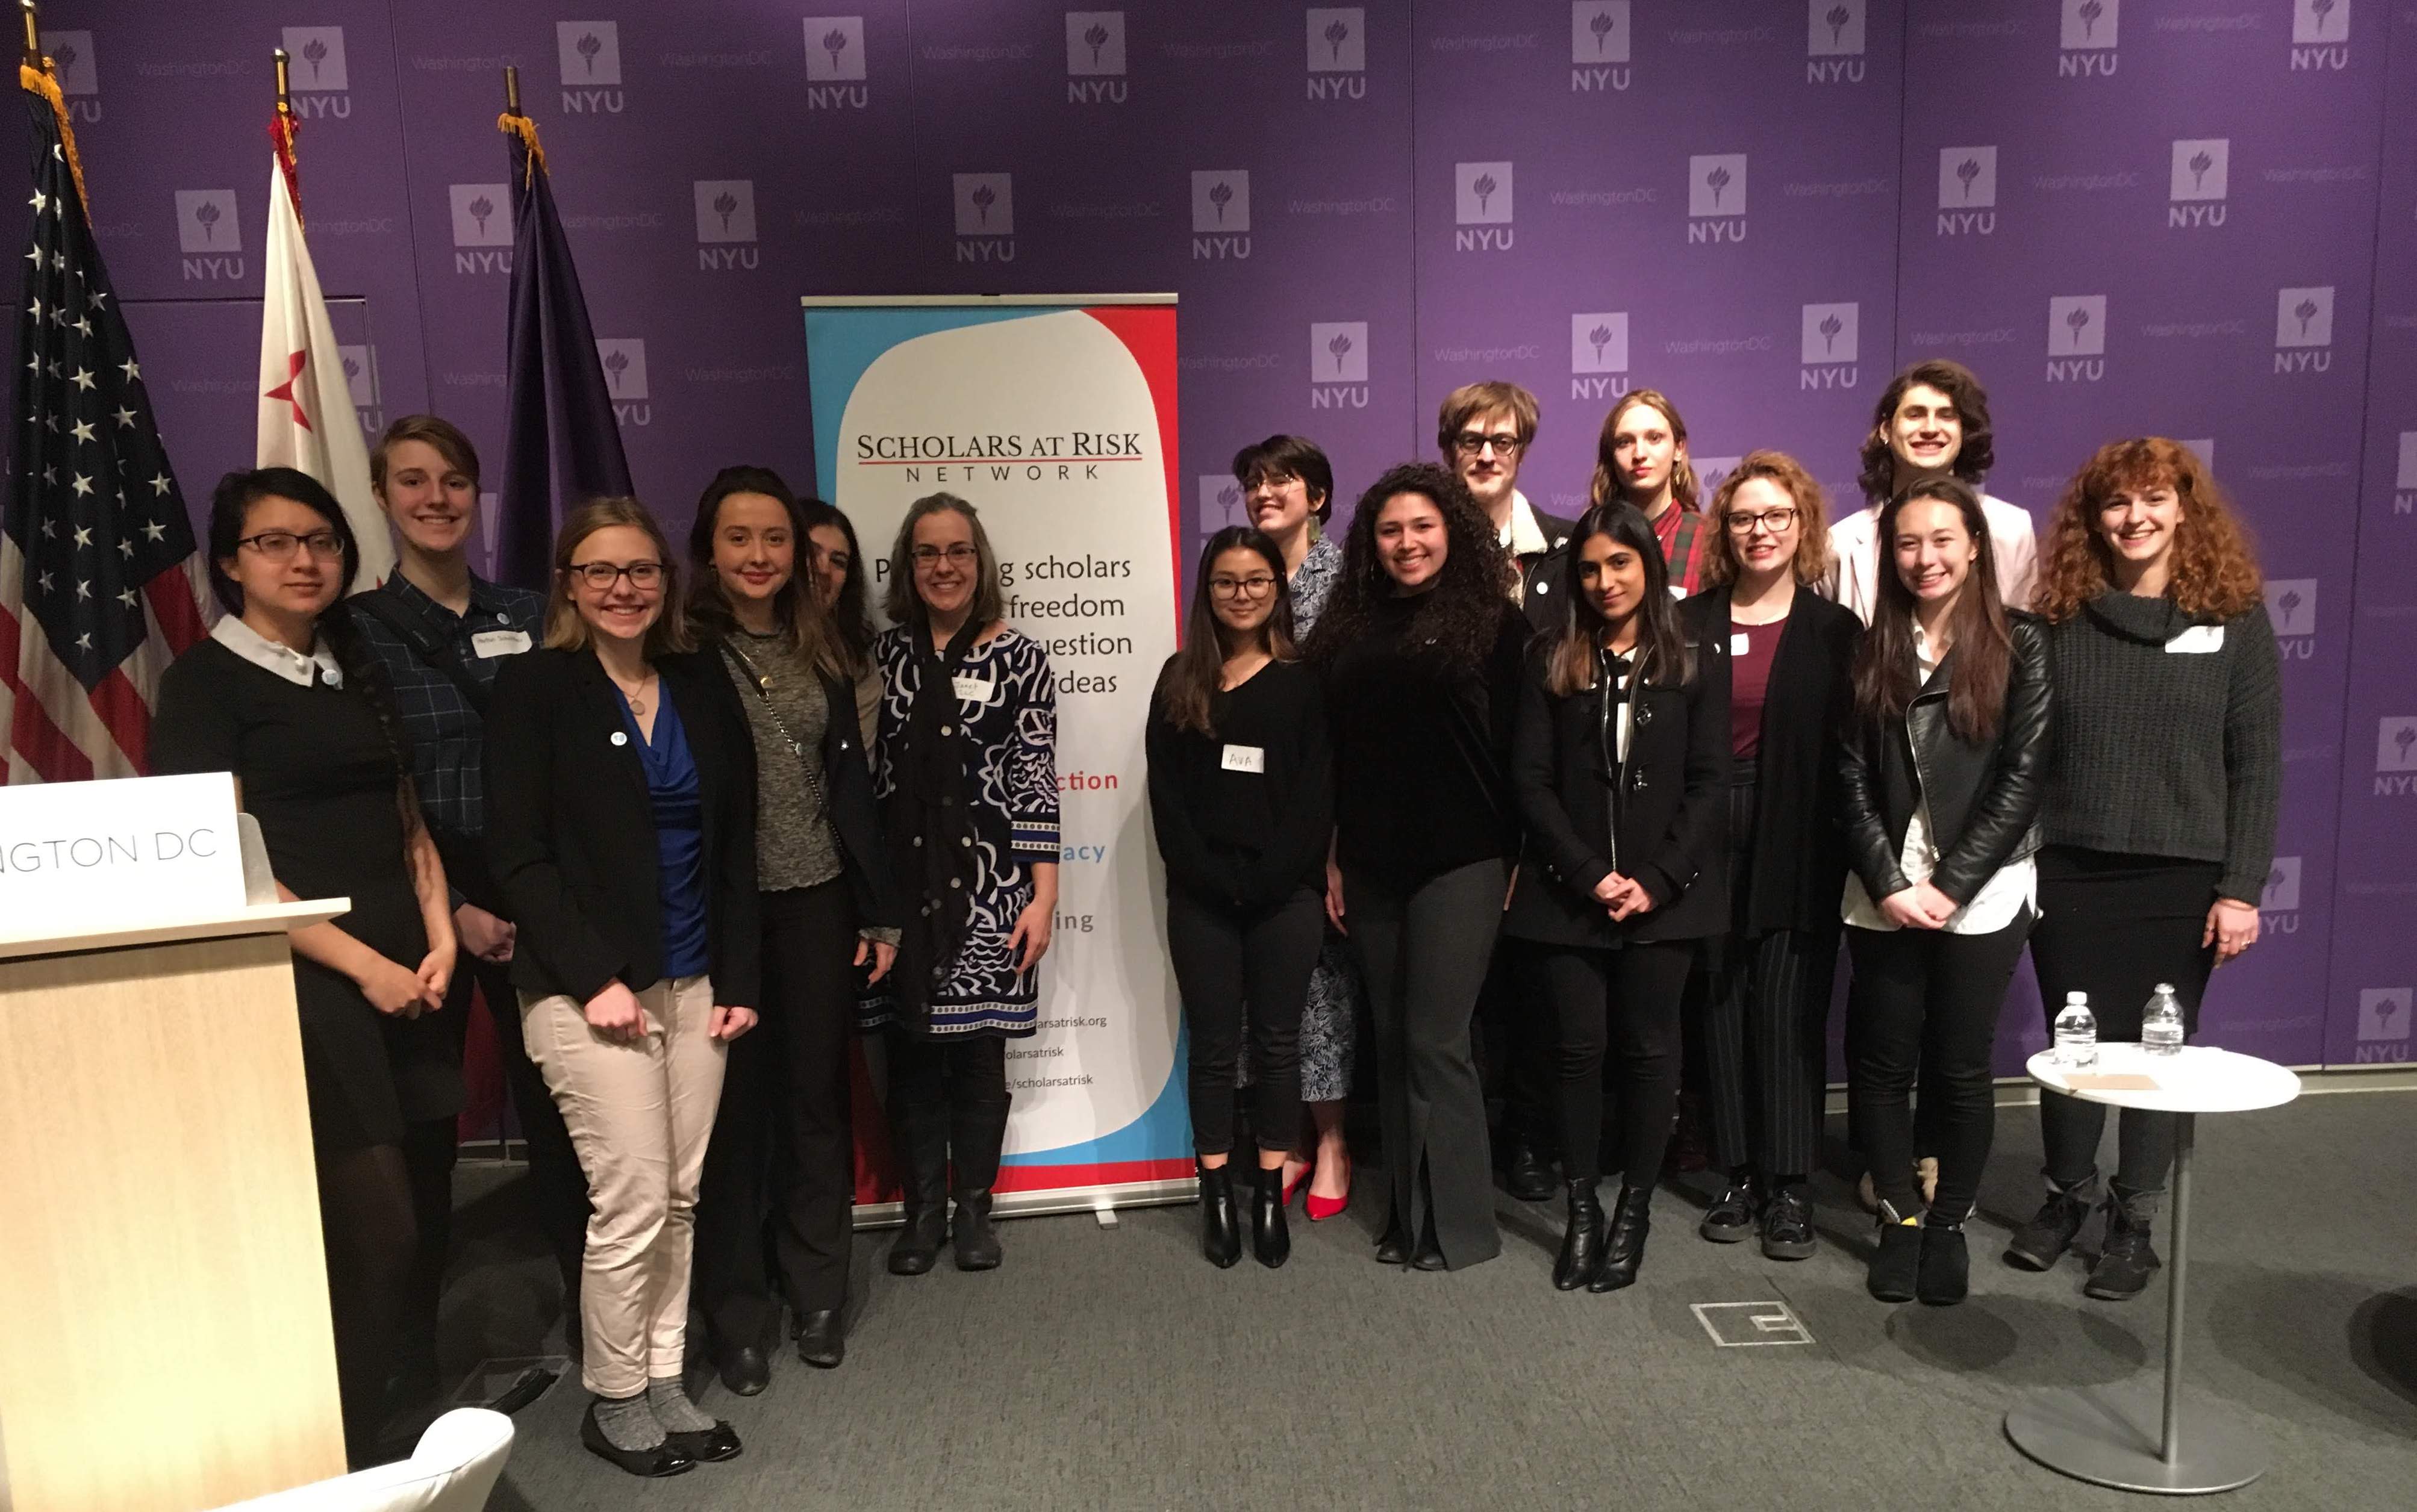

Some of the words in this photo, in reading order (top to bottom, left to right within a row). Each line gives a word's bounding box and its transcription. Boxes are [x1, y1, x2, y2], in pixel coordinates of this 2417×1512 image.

[2059, 54, 2118, 76] NYU
[2291, 48, 2348, 70] NYU
[1573, 69, 1630, 92] NYU
[1807, 61, 1866, 83] NYU
[808, 87, 867, 110] NYU
[1068, 81, 1127, 104] NYU
[1308, 77, 1365, 99] NYU
[67, 101, 102, 123] YU
[292, 96, 351, 119] NYU
[563, 90, 624, 114] NYU
[1937, 213, 1995, 235] NYU
[2169, 205, 2227, 227] NYU
[1456, 229, 1514, 252] NYU
[1689, 220, 1746, 243] NYU
[699, 248, 759, 270] NYU
[956, 240, 1014, 262] NYU
[1193, 238, 1251, 260] NYU
[183, 259, 245, 281] NYU
[2047, 360, 2104, 382] NYU
[2274, 351, 2331, 372] NYU
[1571, 378, 1628, 399] NYU
[1800, 367, 1857, 389] NYU
[1312, 387, 1369, 409] NYU
[613, 405, 651, 426] YU
[858, 435, 1022, 460] SCHOLARS
[1031, 437, 1064, 456] AT
[1073, 432, 1143, 456] RISK
[1025, 554, 1131, 579] scholars
[1009, 593, 1125, 619] freedom
[2279, 639, 2315, 660] YU
[1056, 771, 1118, 790] ction
[155, 828, 217, 861] DC
[1063, 844, 1106, 864] acy
[1055, 910, 1094, 933] ing
[2265, 915, 2300, 934] YU
[1037, 1016, 1108, 1029] arsatrisk.org
[1006, 1047, 1065, 1060] olarsatrisk
[2356, 1044, 2408, 1063] NYU
[1005, 1074, 1094, 1089] e/scholarsatrisk
